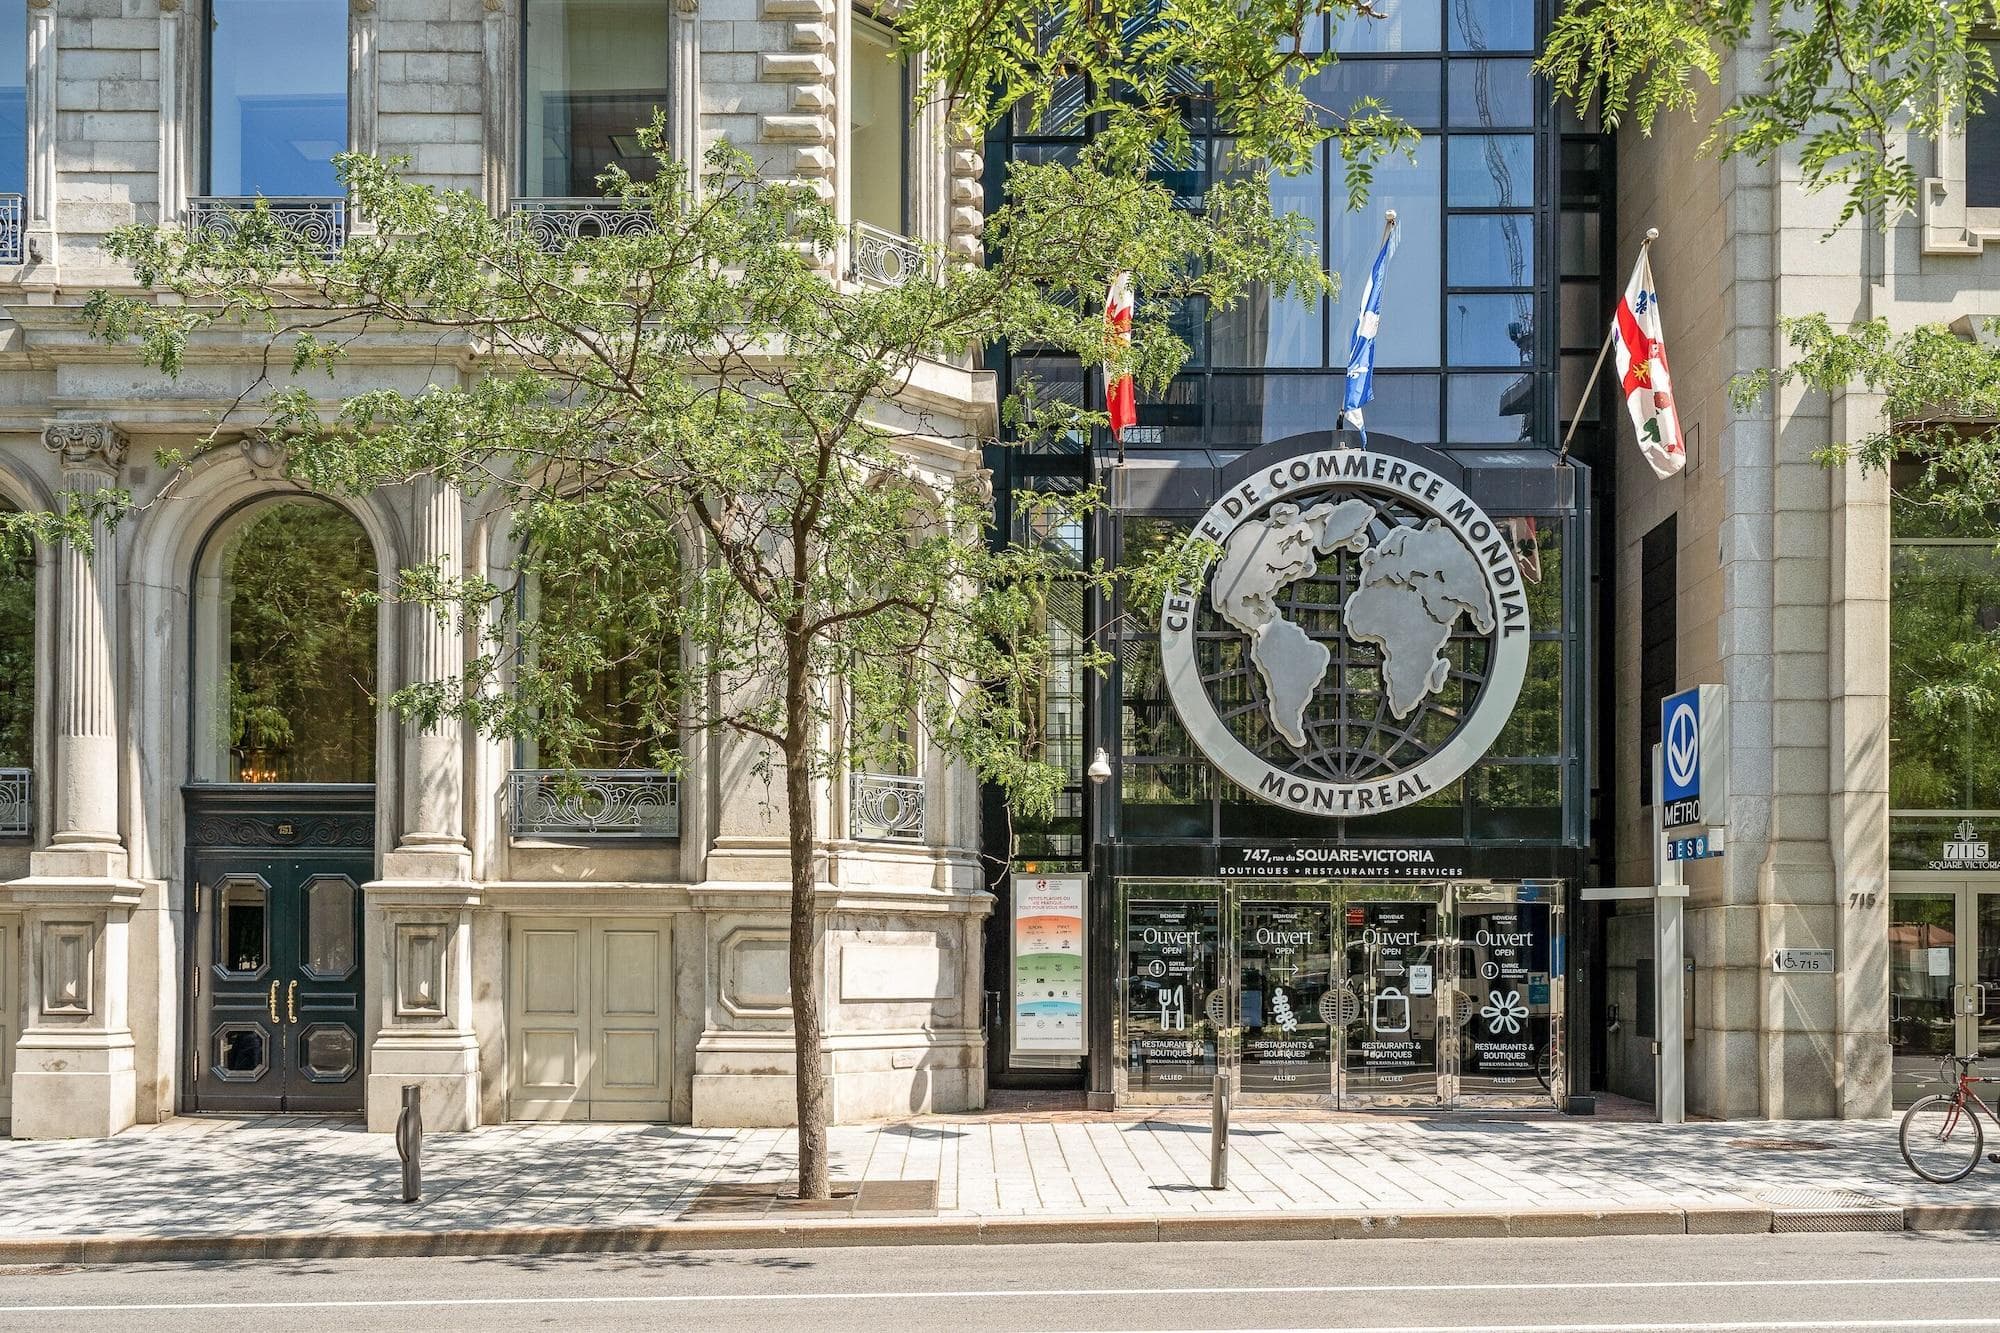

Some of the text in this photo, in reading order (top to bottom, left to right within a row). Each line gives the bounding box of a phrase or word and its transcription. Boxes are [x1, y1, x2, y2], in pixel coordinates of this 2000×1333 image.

[1167, 454, 1526, 638] CENE DE COMMERCE MONDIAL
[1259, 771, 1432, 810] MONTREAL
[1664, 800, 1700, 827] MÉTRO
[1242, 848, 1435, 863] 747, rue du SQUARE-VICTORIA
[1945, 844, 1987, 859] 715
[1928, 860, 1963, 870] SQUARE
[1220, 866, 1463, 876] BOUTIQUES RESTAURANTS SERVICES
[1849, 892, 1876, 911] 715
[1143, 927, 1200, 945] Ouvert
[1256, 927, 1313, 945] Ouvert
[1362, 928, 1420, 946] Ouvert
[1475, 929, 1534, 947] Ouvert
[1162, 947, 1182, 955] OPEN
[1275, 947, 1295, 955] OPEN
[1381, 948, 1402, 956] OPEN
[1494, 949, 1515, 957] OPEN
[1799, 960, 1819, 970] 715
[1141, 1040, 1194, 1049] RESTAURANTS
[1254, 1041, 1307, 1049] RESTAURANTS
[1361, 1042, 1421, 1050] RESTAURANTS &
[1474, 1043, 1535, 1051] RESTAURANTS &
[1150, 1049, 1192, 1058] BOUTIQUES
[1263, 1050, 1306, 1058] BOUTIQUES
[1483, 1051, 1526, 1060] BOUTIQUES
